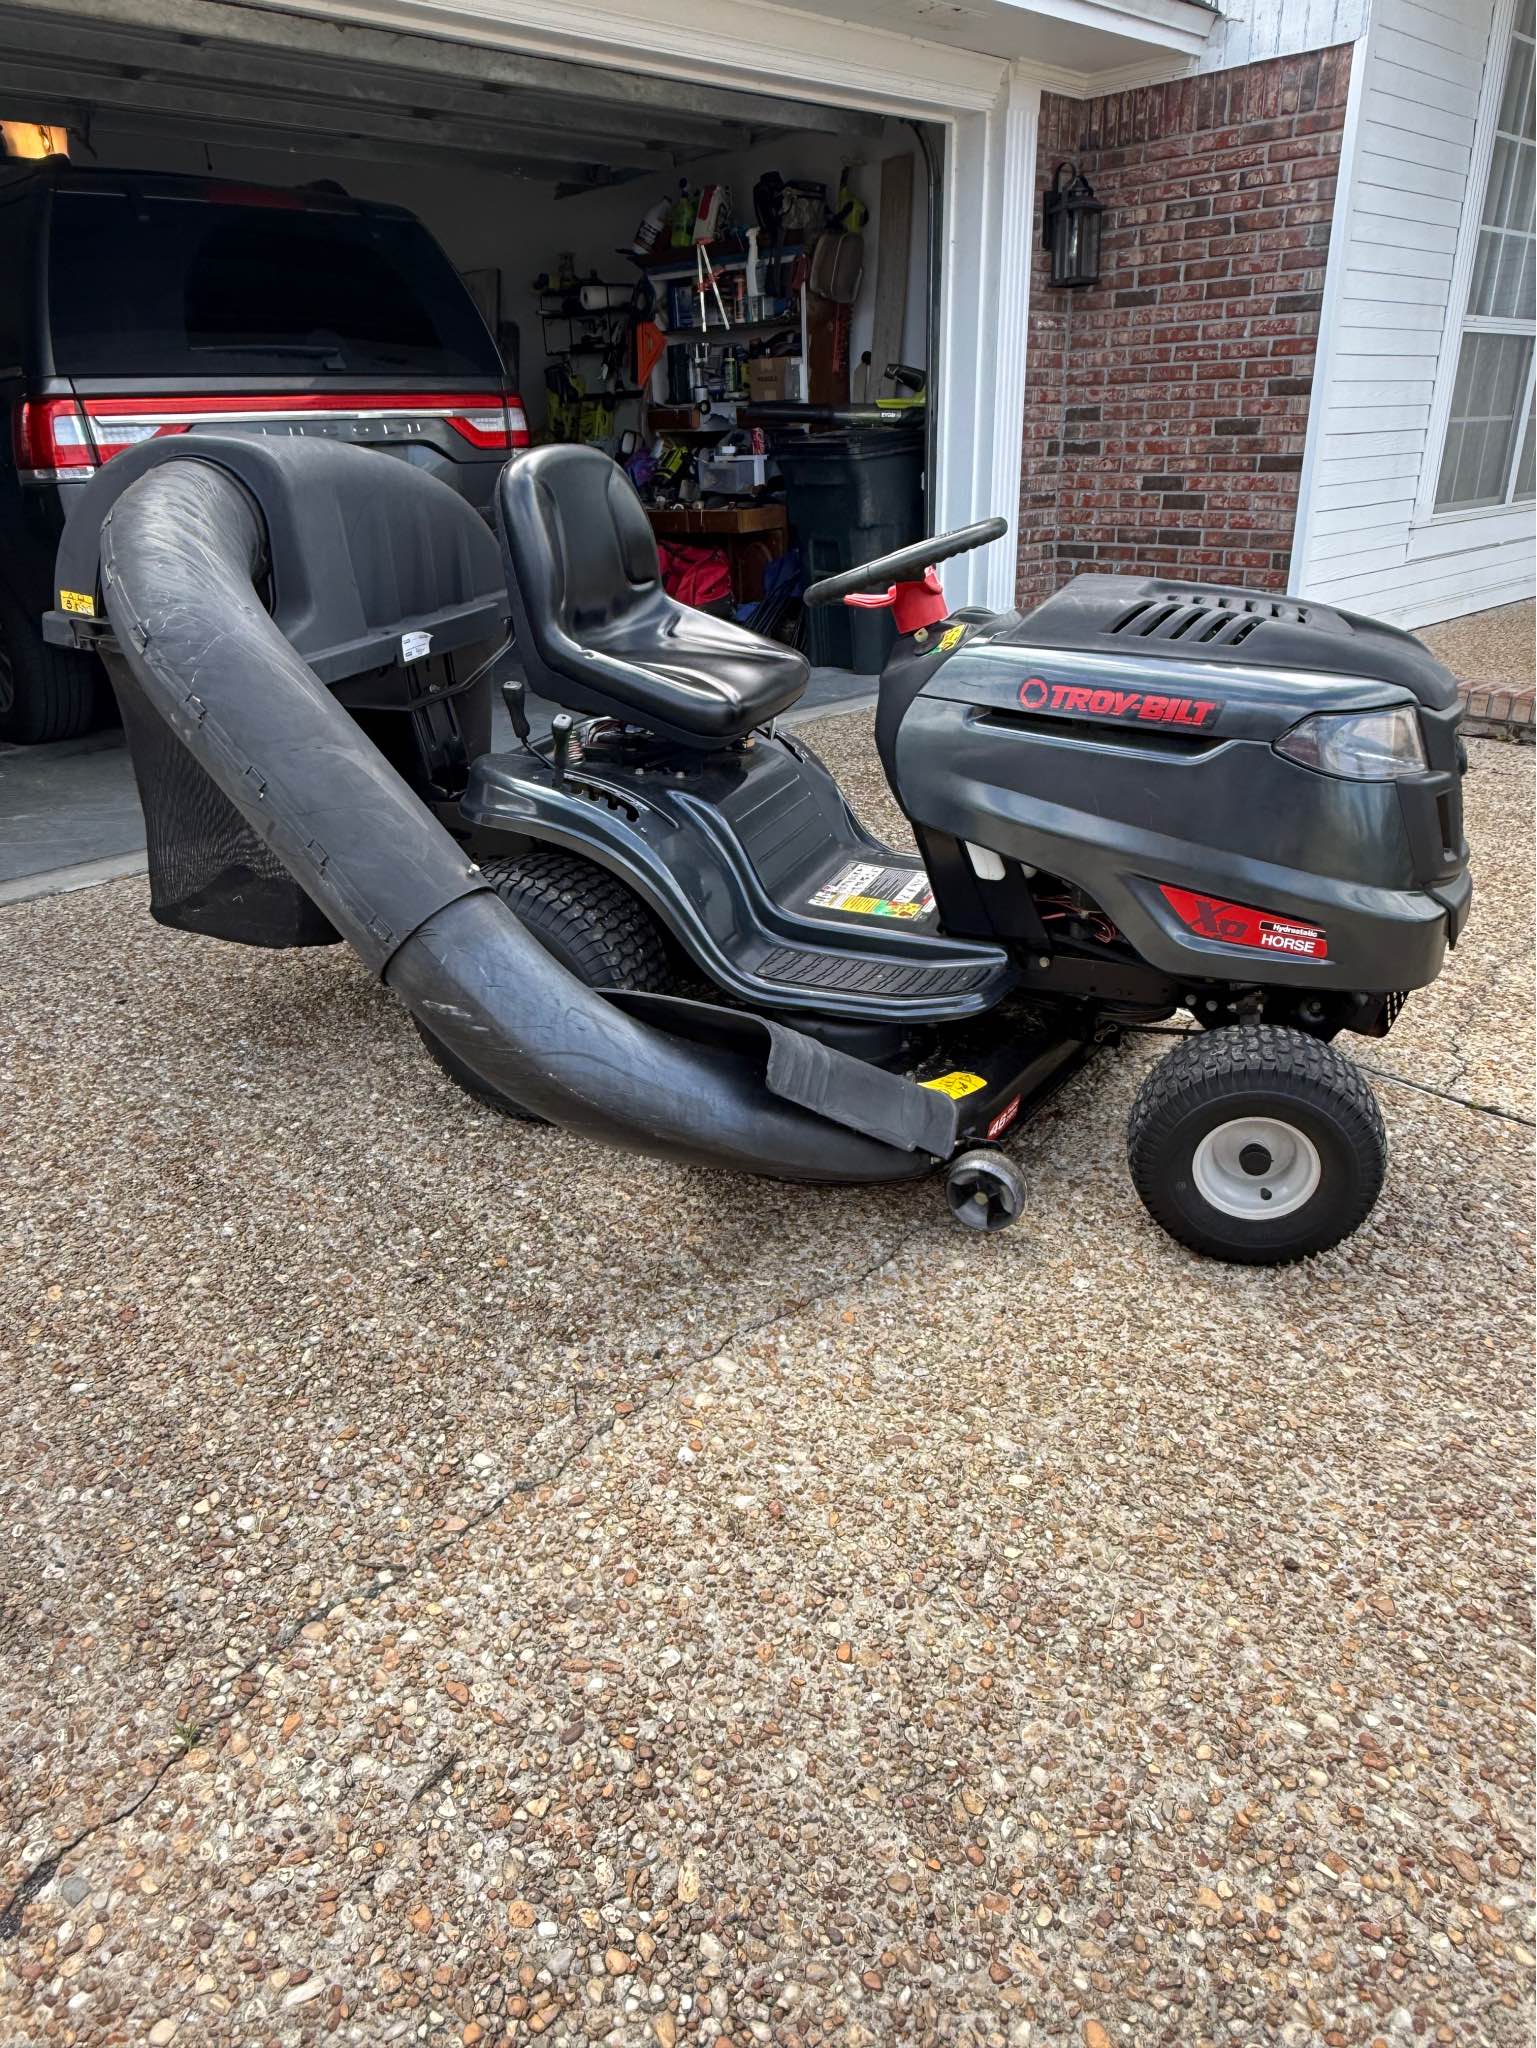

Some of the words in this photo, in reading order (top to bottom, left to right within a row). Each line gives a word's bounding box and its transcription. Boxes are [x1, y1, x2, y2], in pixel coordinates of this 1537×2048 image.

[1050, 684, 1216, 726] TROY-BILT
[1273, 923, 1318, 938] Hydrostatic
[1261, 933, 1316, 953] HORSE
